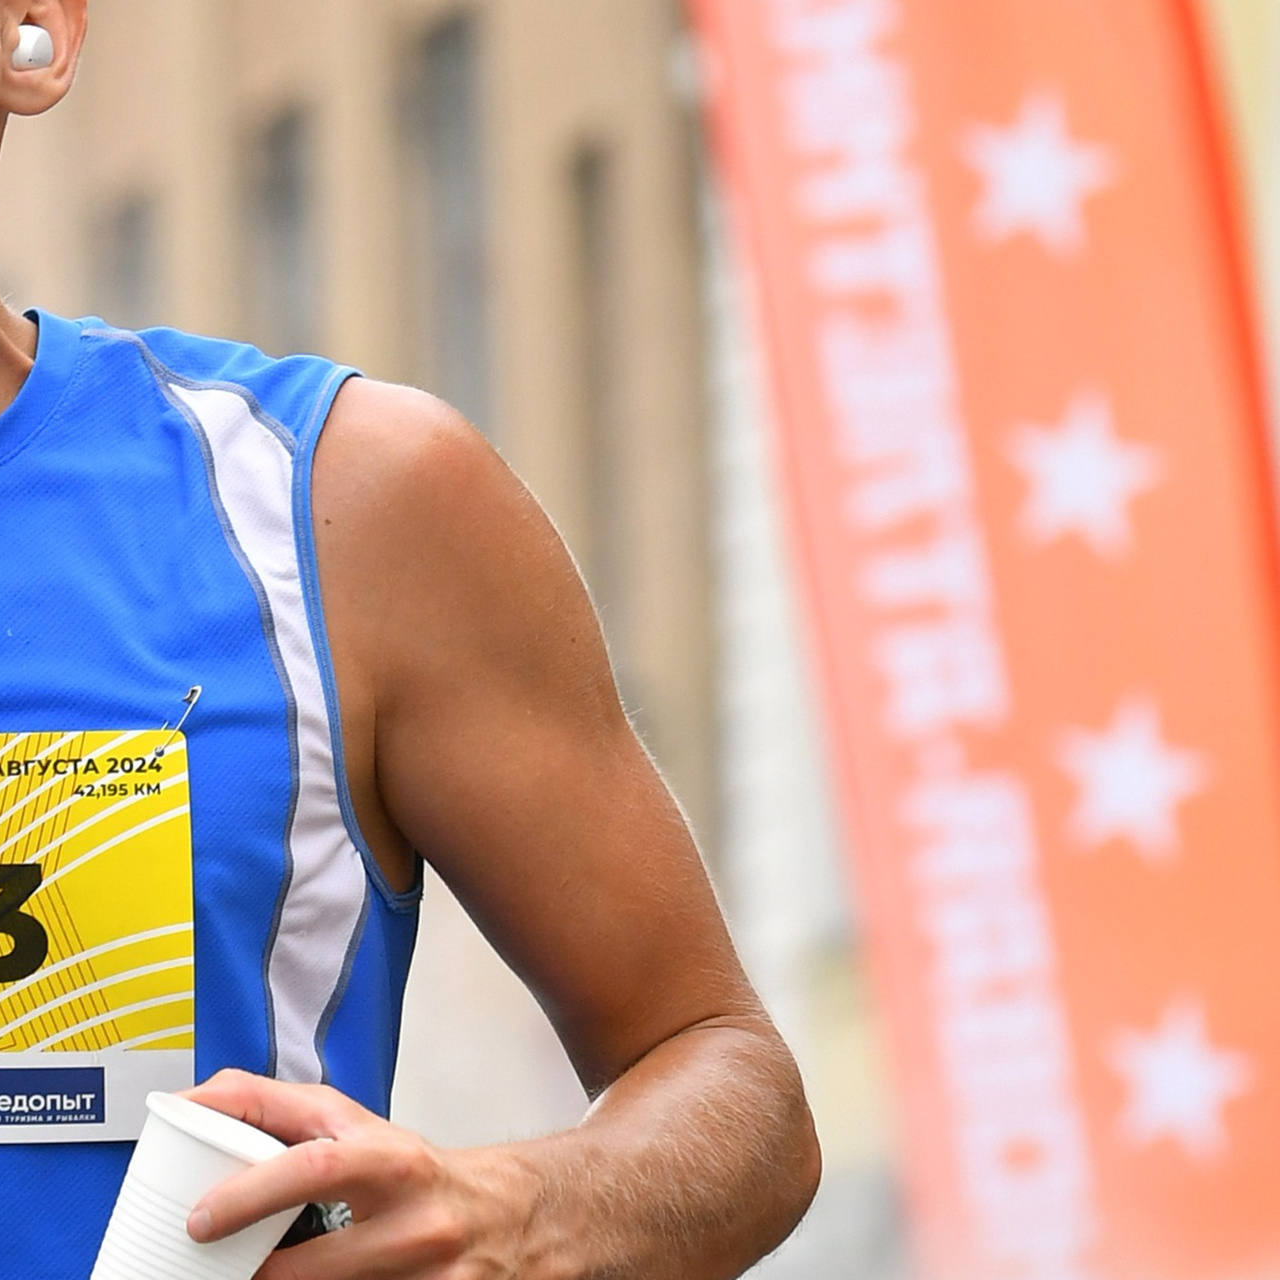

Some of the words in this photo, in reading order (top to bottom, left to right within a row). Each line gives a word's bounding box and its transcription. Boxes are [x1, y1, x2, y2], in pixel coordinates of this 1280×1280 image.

[106, 757, 162, 774] 2024
[74, 783, 128, 799] 42,195
[134, 783, 162, 796] КМ
